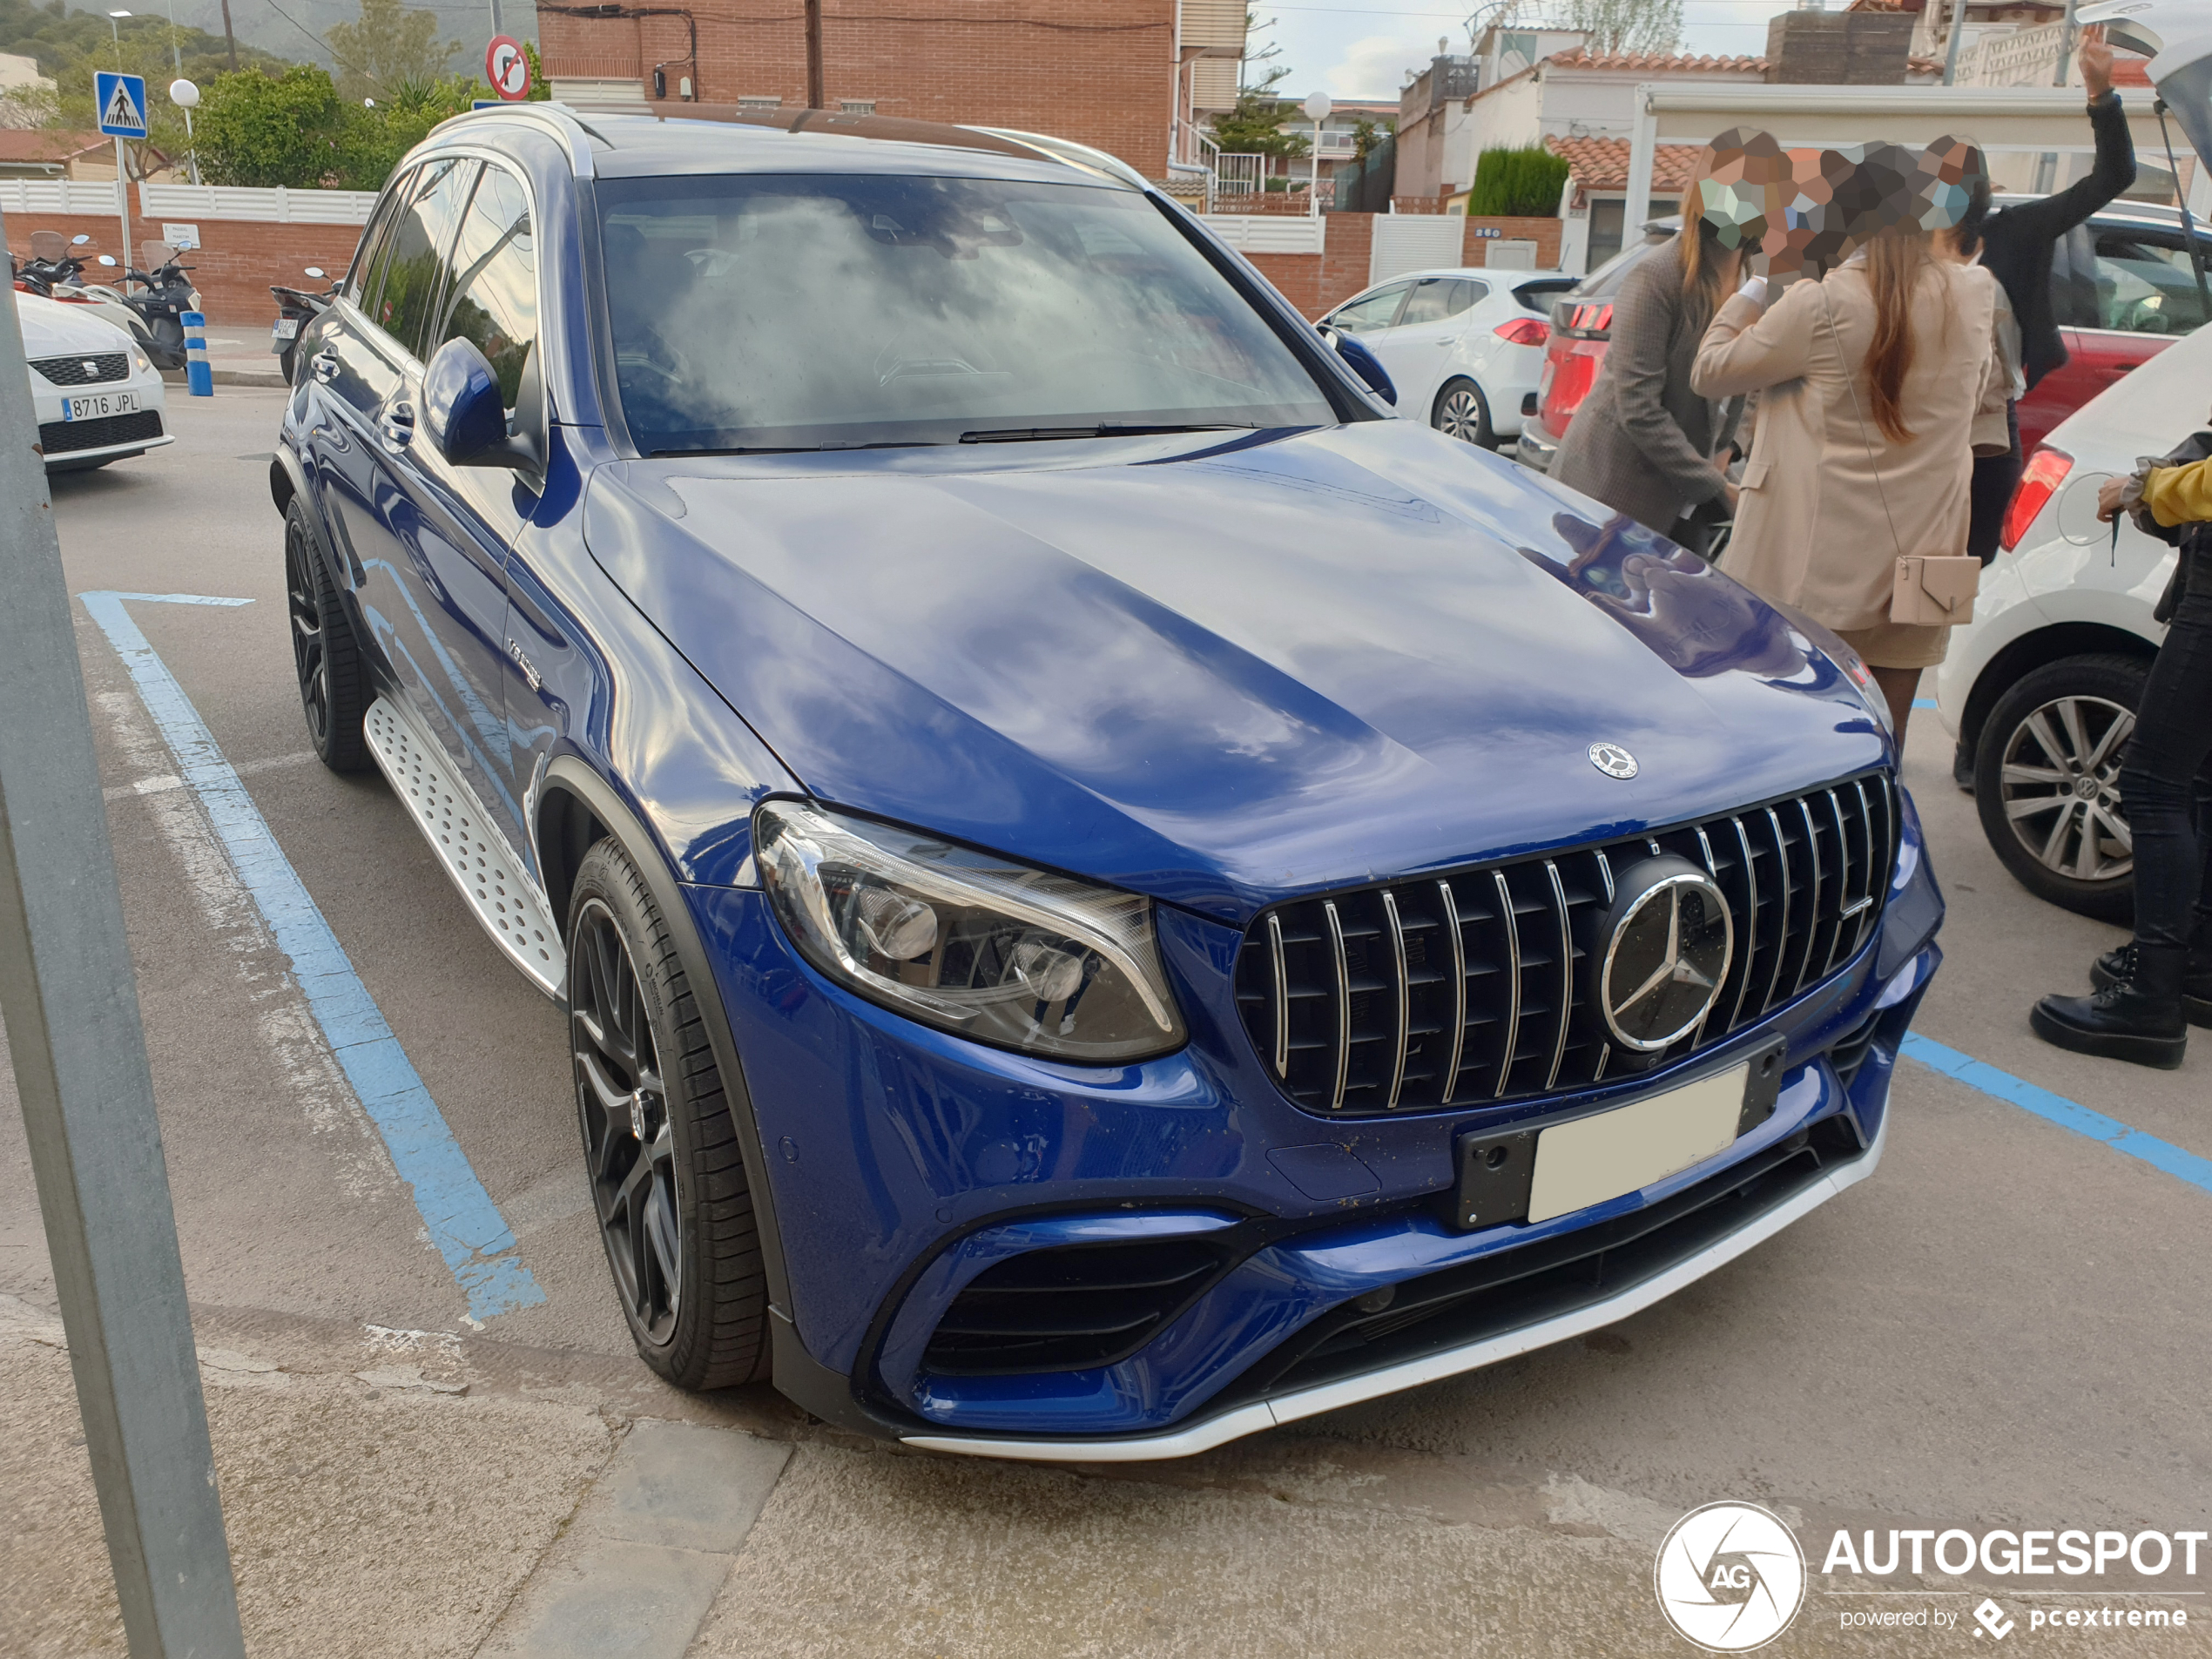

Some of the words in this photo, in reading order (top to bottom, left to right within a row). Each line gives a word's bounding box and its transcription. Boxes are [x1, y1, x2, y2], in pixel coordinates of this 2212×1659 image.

[73, 397, 109, 417] 8716
[115, 394, 138, 412] JPL
[651, 977, 664, 1015] MICHELIN
